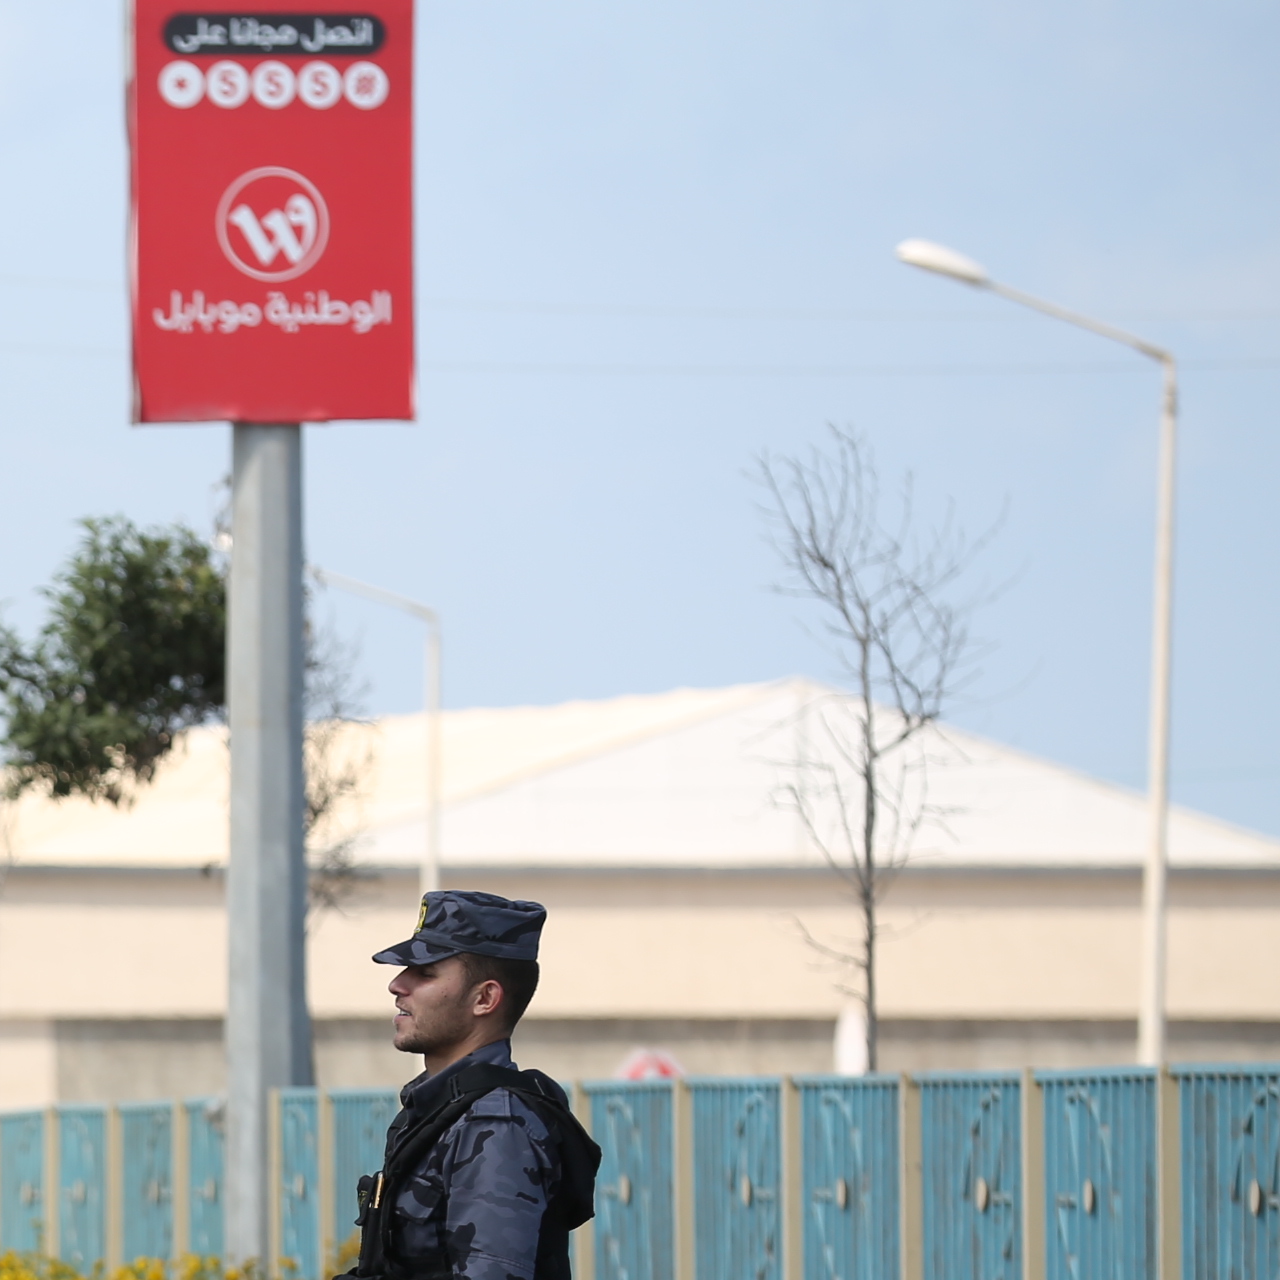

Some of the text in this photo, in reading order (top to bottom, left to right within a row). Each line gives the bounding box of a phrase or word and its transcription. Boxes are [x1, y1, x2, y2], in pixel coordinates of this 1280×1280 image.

[172, 17, 229, 53] على
[299, 17, 374, 52] اتصل
[152, 289, 393, 334] الوطنية موبايل
